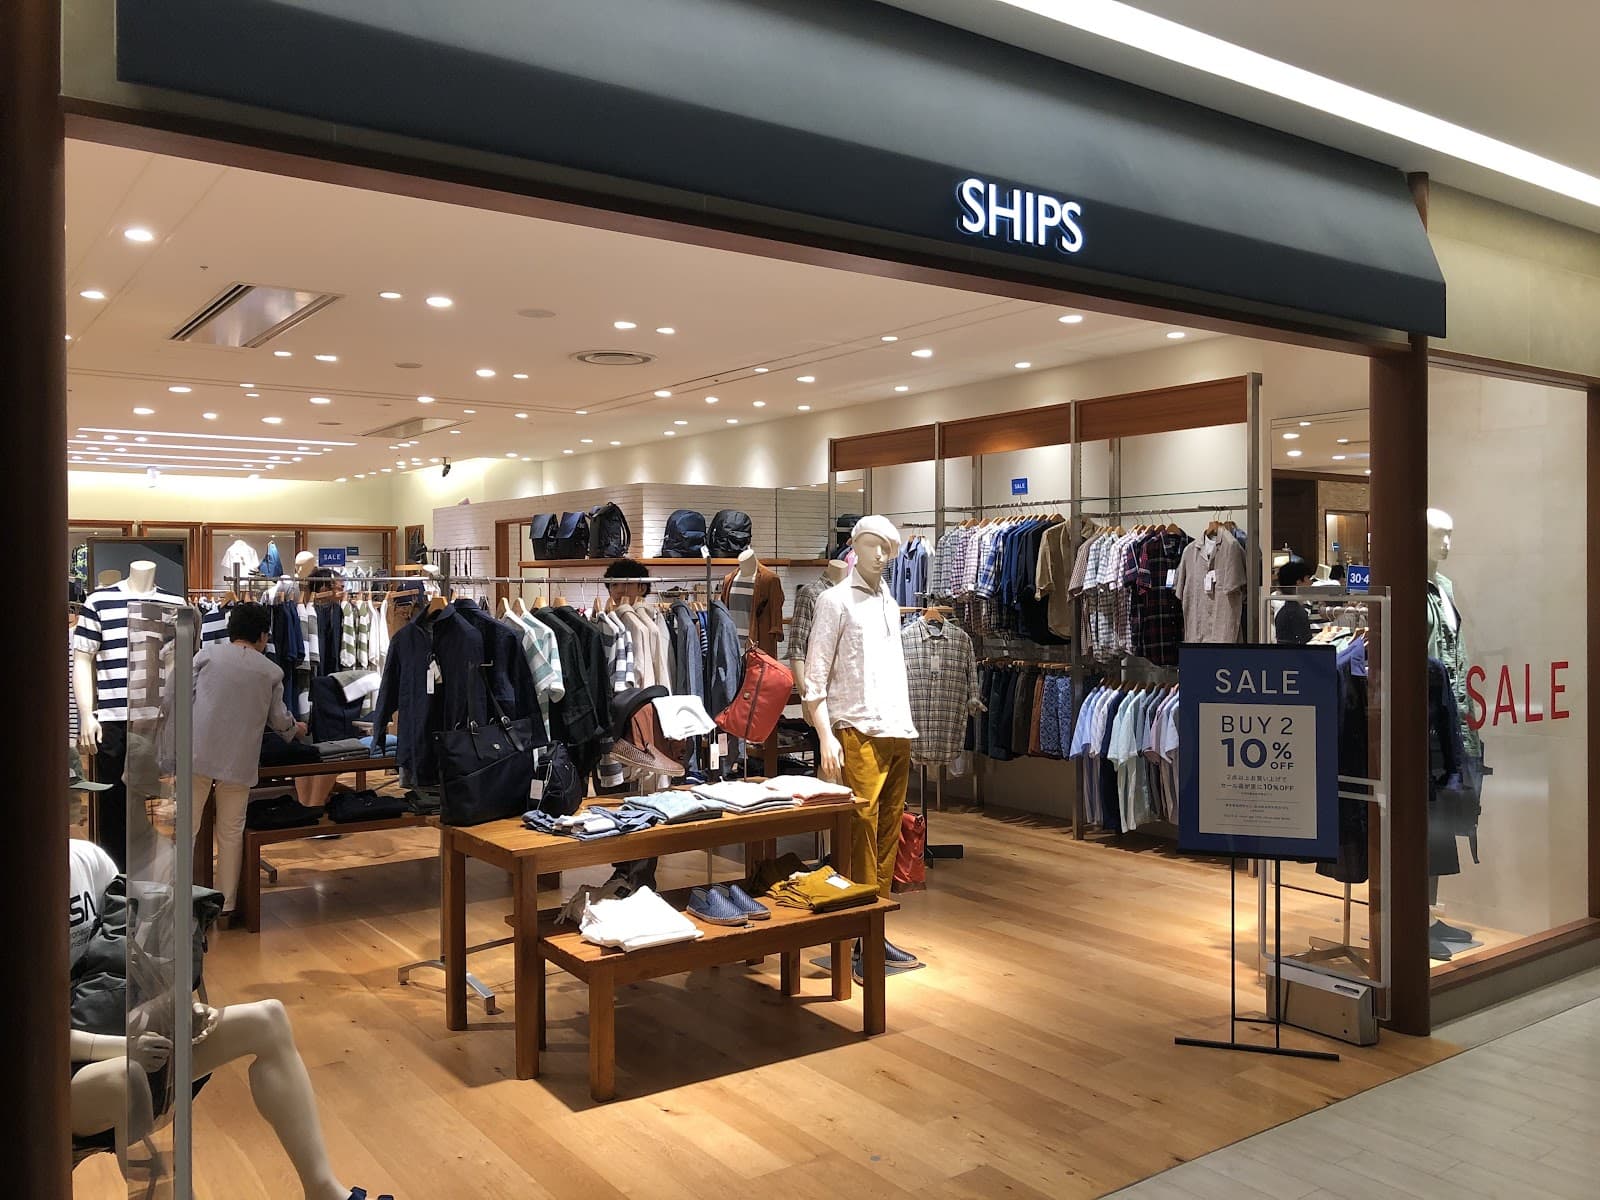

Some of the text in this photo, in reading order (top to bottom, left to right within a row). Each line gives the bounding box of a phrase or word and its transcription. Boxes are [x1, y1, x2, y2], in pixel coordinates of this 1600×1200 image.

[958, 178, 1083, 253] SHIPS
[323, 553, 341, 561] SALE
[1215, 668, 1300, 695] SALE
[1465, 661, 1570, 731] SALE
[1221, 715, 1293, 735] BUY 2
[1270, 761, 1294, 770] OFF
